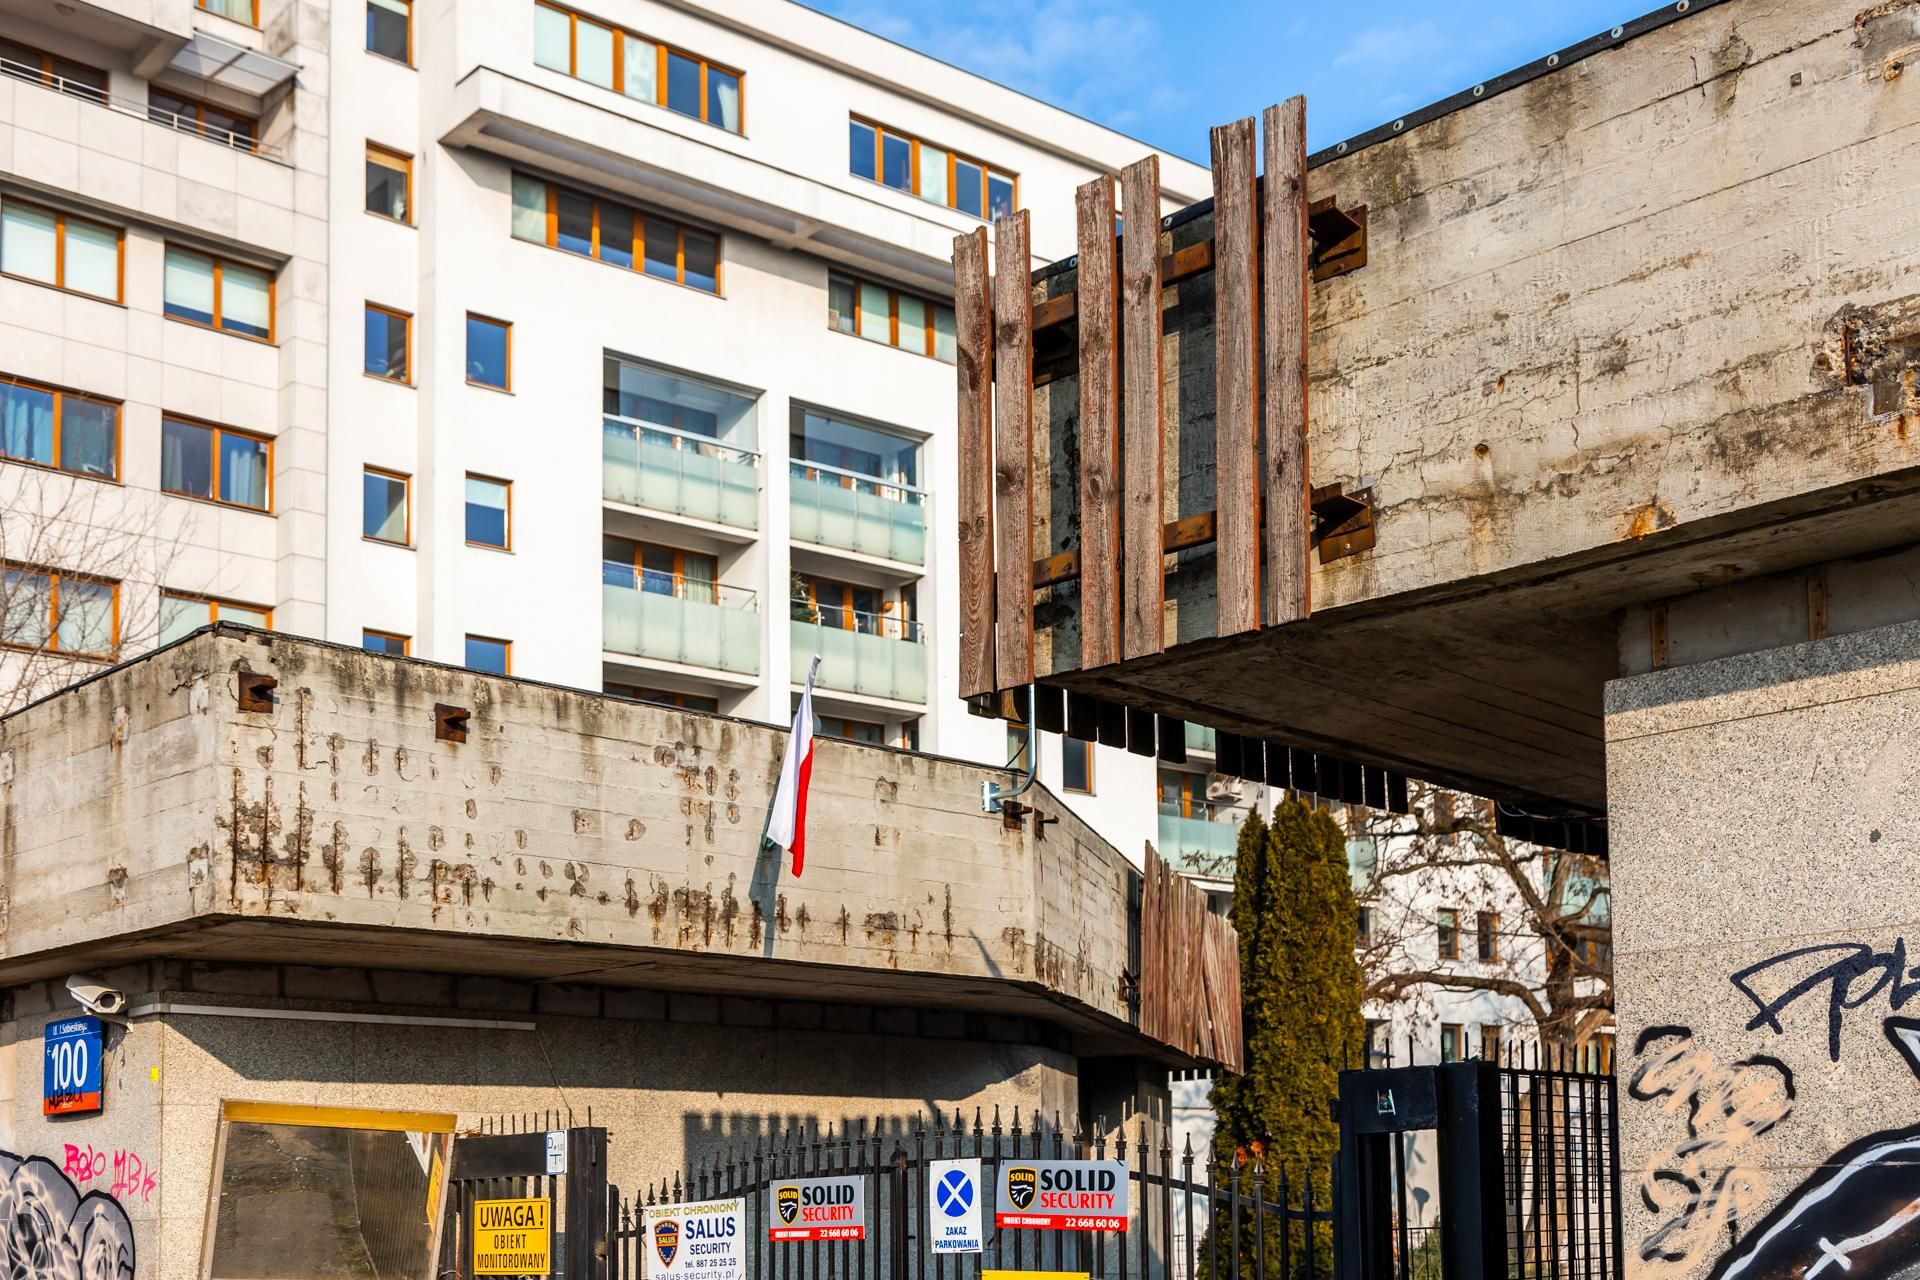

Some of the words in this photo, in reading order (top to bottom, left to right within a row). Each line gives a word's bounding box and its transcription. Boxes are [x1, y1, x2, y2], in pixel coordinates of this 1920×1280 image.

[51, 1039, 88, 1091] 100
[1010, 1172, 1035, 1182] SOLID
[1040, 1168, 1116, 1192] SOLID
[779, 1191, 798, 1200] SOLID
[802, 1184, 855, 1206] SOLID
[1040, 1192, 1115, 1210] SECURITY
[648, 1207, 681, 1219] OBIEKT
[683, 1202, 740, 1216] CHRONIONY
[802, 1205, 855, 1222] SECURITY
[685, 1216, 736, 1240] SALUS
[1065, 1217, 1076, 1227] 22
[1077, 1218, 1095, 1228] 668
[1095, 1218, 1108, 1228] 60
[1108, 1219, 1121, 1229] 06
[819, 1229, 828, 1238] 22
[828, 1229, 841, 1238] 668
[841, 1228, 850, 1237] 60
[850, 1228, 859, 1237] 06
[945, 1226, 967, 1236] ZAKAZ
[494, 1233, 527, 1250] OBIEKT
[658, 1236, 676, 1245] SALUS
[935, 1239, 979, 1249] PARKOWANIA
[689, 1242, 731, 1256] SECURITY
[477, 1252, 546, 1269] MONITOROWANY
[685, 1260, 695, 1269] tel.
[696, 1259, 708, 1269] 887
[709, 1258, 717, 1268] 25
[719, 1258, 727, 1267] 25
[728, 1257, 737, 1266] 25
[655, 1269, 735, 1280] salus-security.pl
